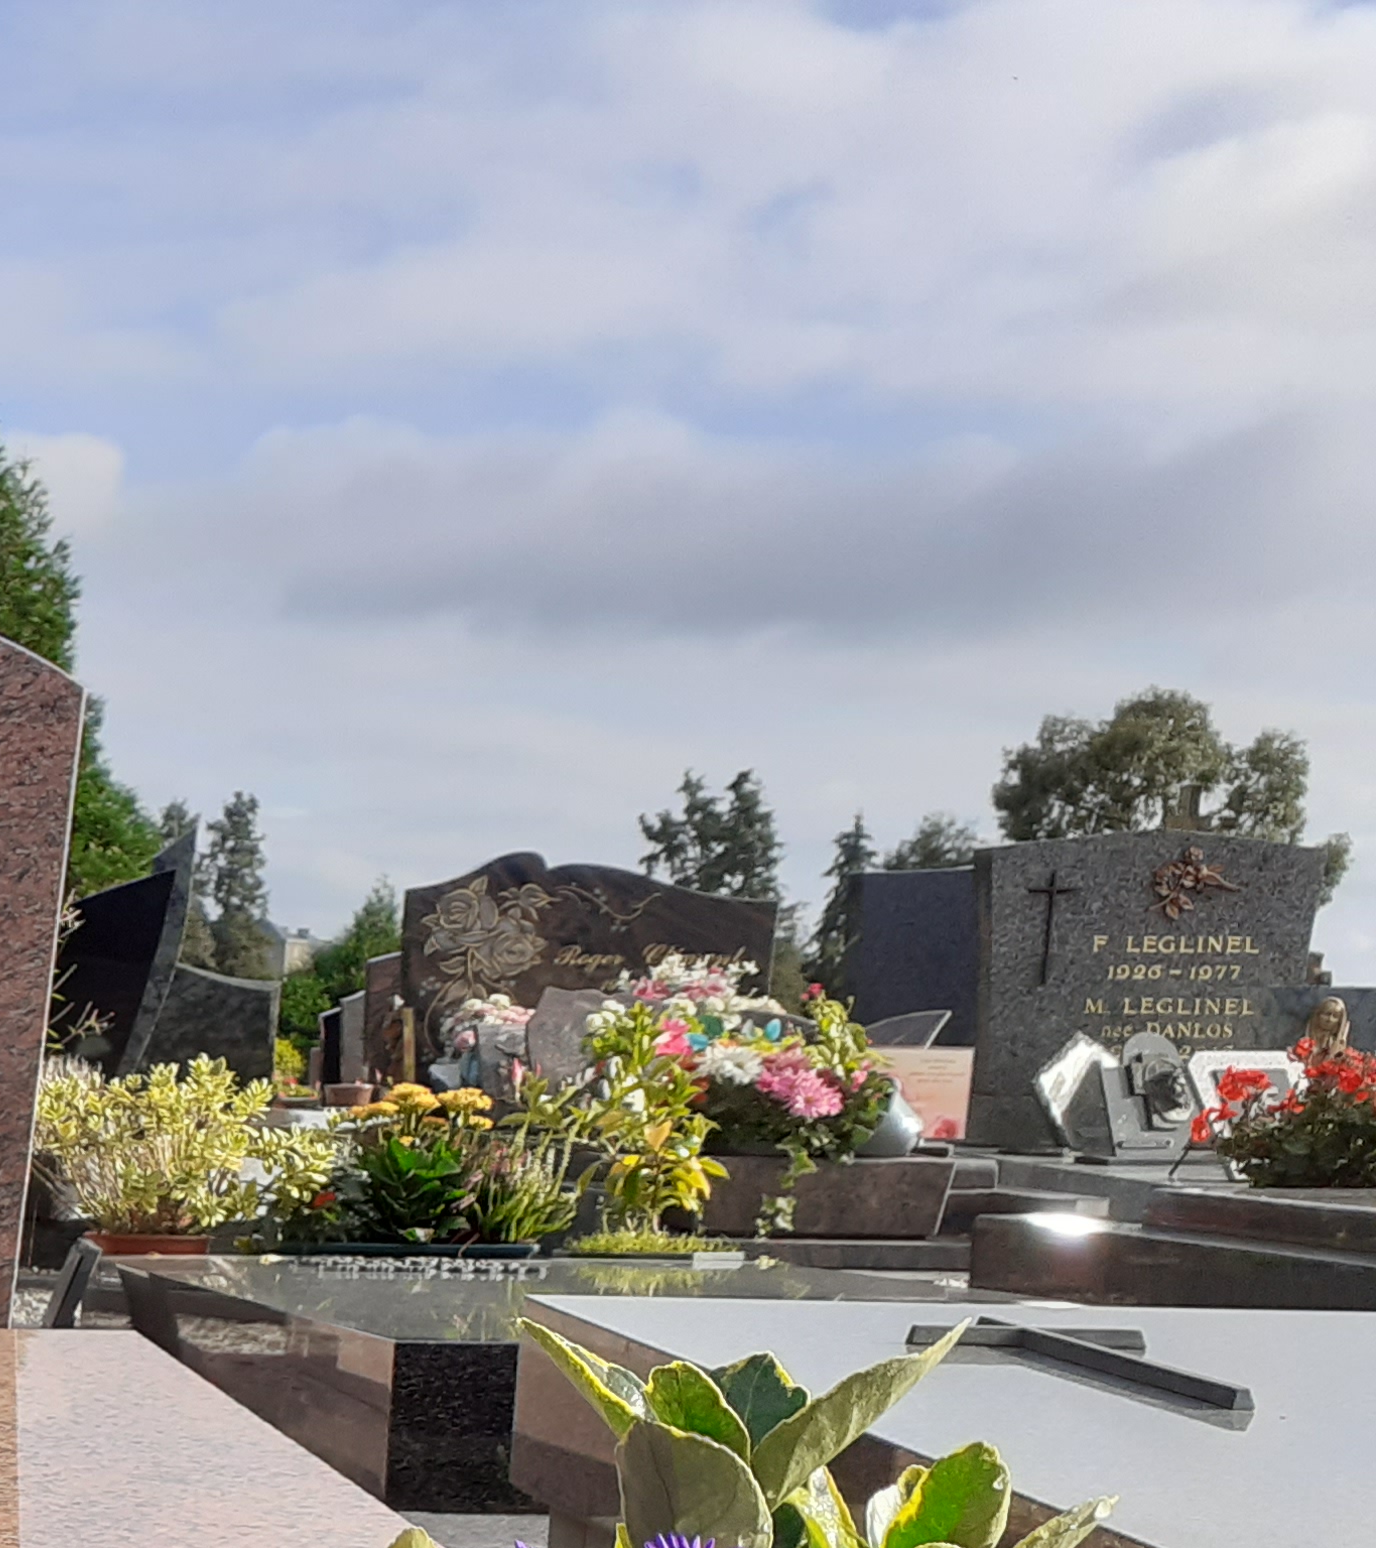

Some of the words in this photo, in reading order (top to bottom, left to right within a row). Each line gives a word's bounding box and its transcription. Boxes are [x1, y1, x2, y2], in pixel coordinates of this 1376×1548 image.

[1126, 934, 1260, 954] LEGLINEL
[553, 943, 626, 974] Roger
[1107, 964, 1162, 980] 1926
[1189, 965, 1241, 980] 1977
[1123, 996, 1255, 1016] LEGLINEL
[1146, 1022, 1233, 1039] DANLOS
